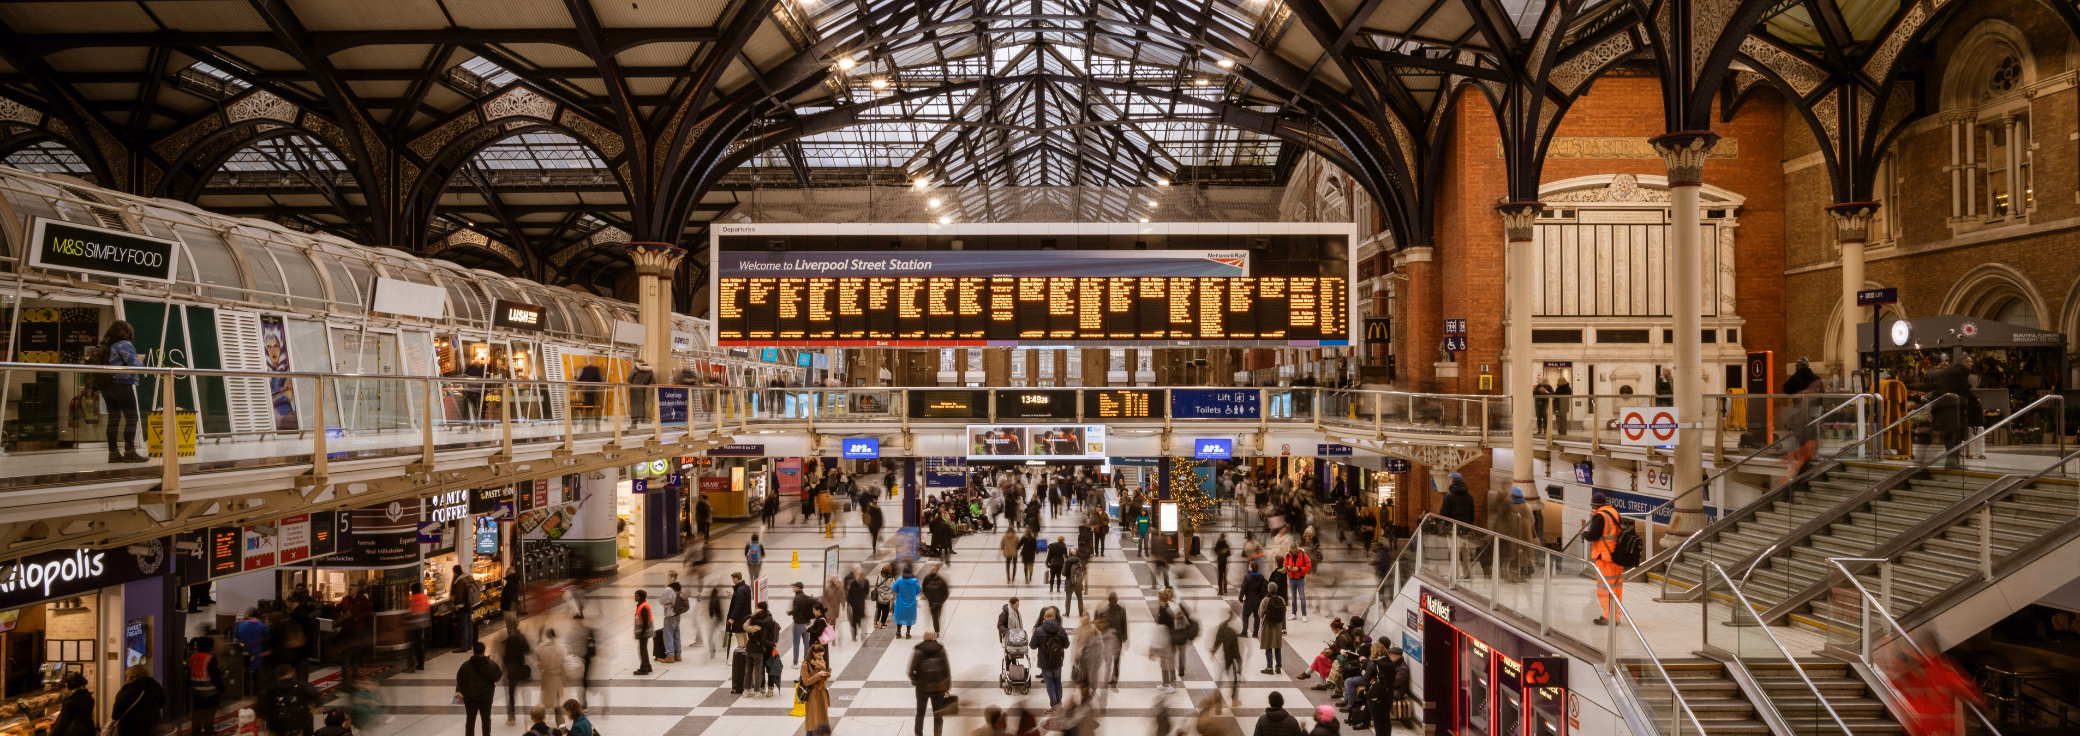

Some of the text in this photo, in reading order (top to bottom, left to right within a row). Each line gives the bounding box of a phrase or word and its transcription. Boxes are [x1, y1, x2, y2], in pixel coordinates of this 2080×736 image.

[52, 236, 163, 268] M&S SIMPLY FOOD
[739, 259, 932, 273] Welcome to Liverpool Street Station
[508, 308, 528, 323] LUSH
[1196, 406, 1221, 414] Toilets
[574, 475, 579, 488] 7
[636, 482, 642, 490] 6
[671, 476, 677, 484] 7
[439, 490, 461, 504] AMT
[432, 504, 468, 523] COFFEE
[1628, 500, 1648, 513] STREET
[340, 513, 349, 532] 5
[1427, 594, 1450, 621] NatWest
[127, 629, 142, 637] TREATS
